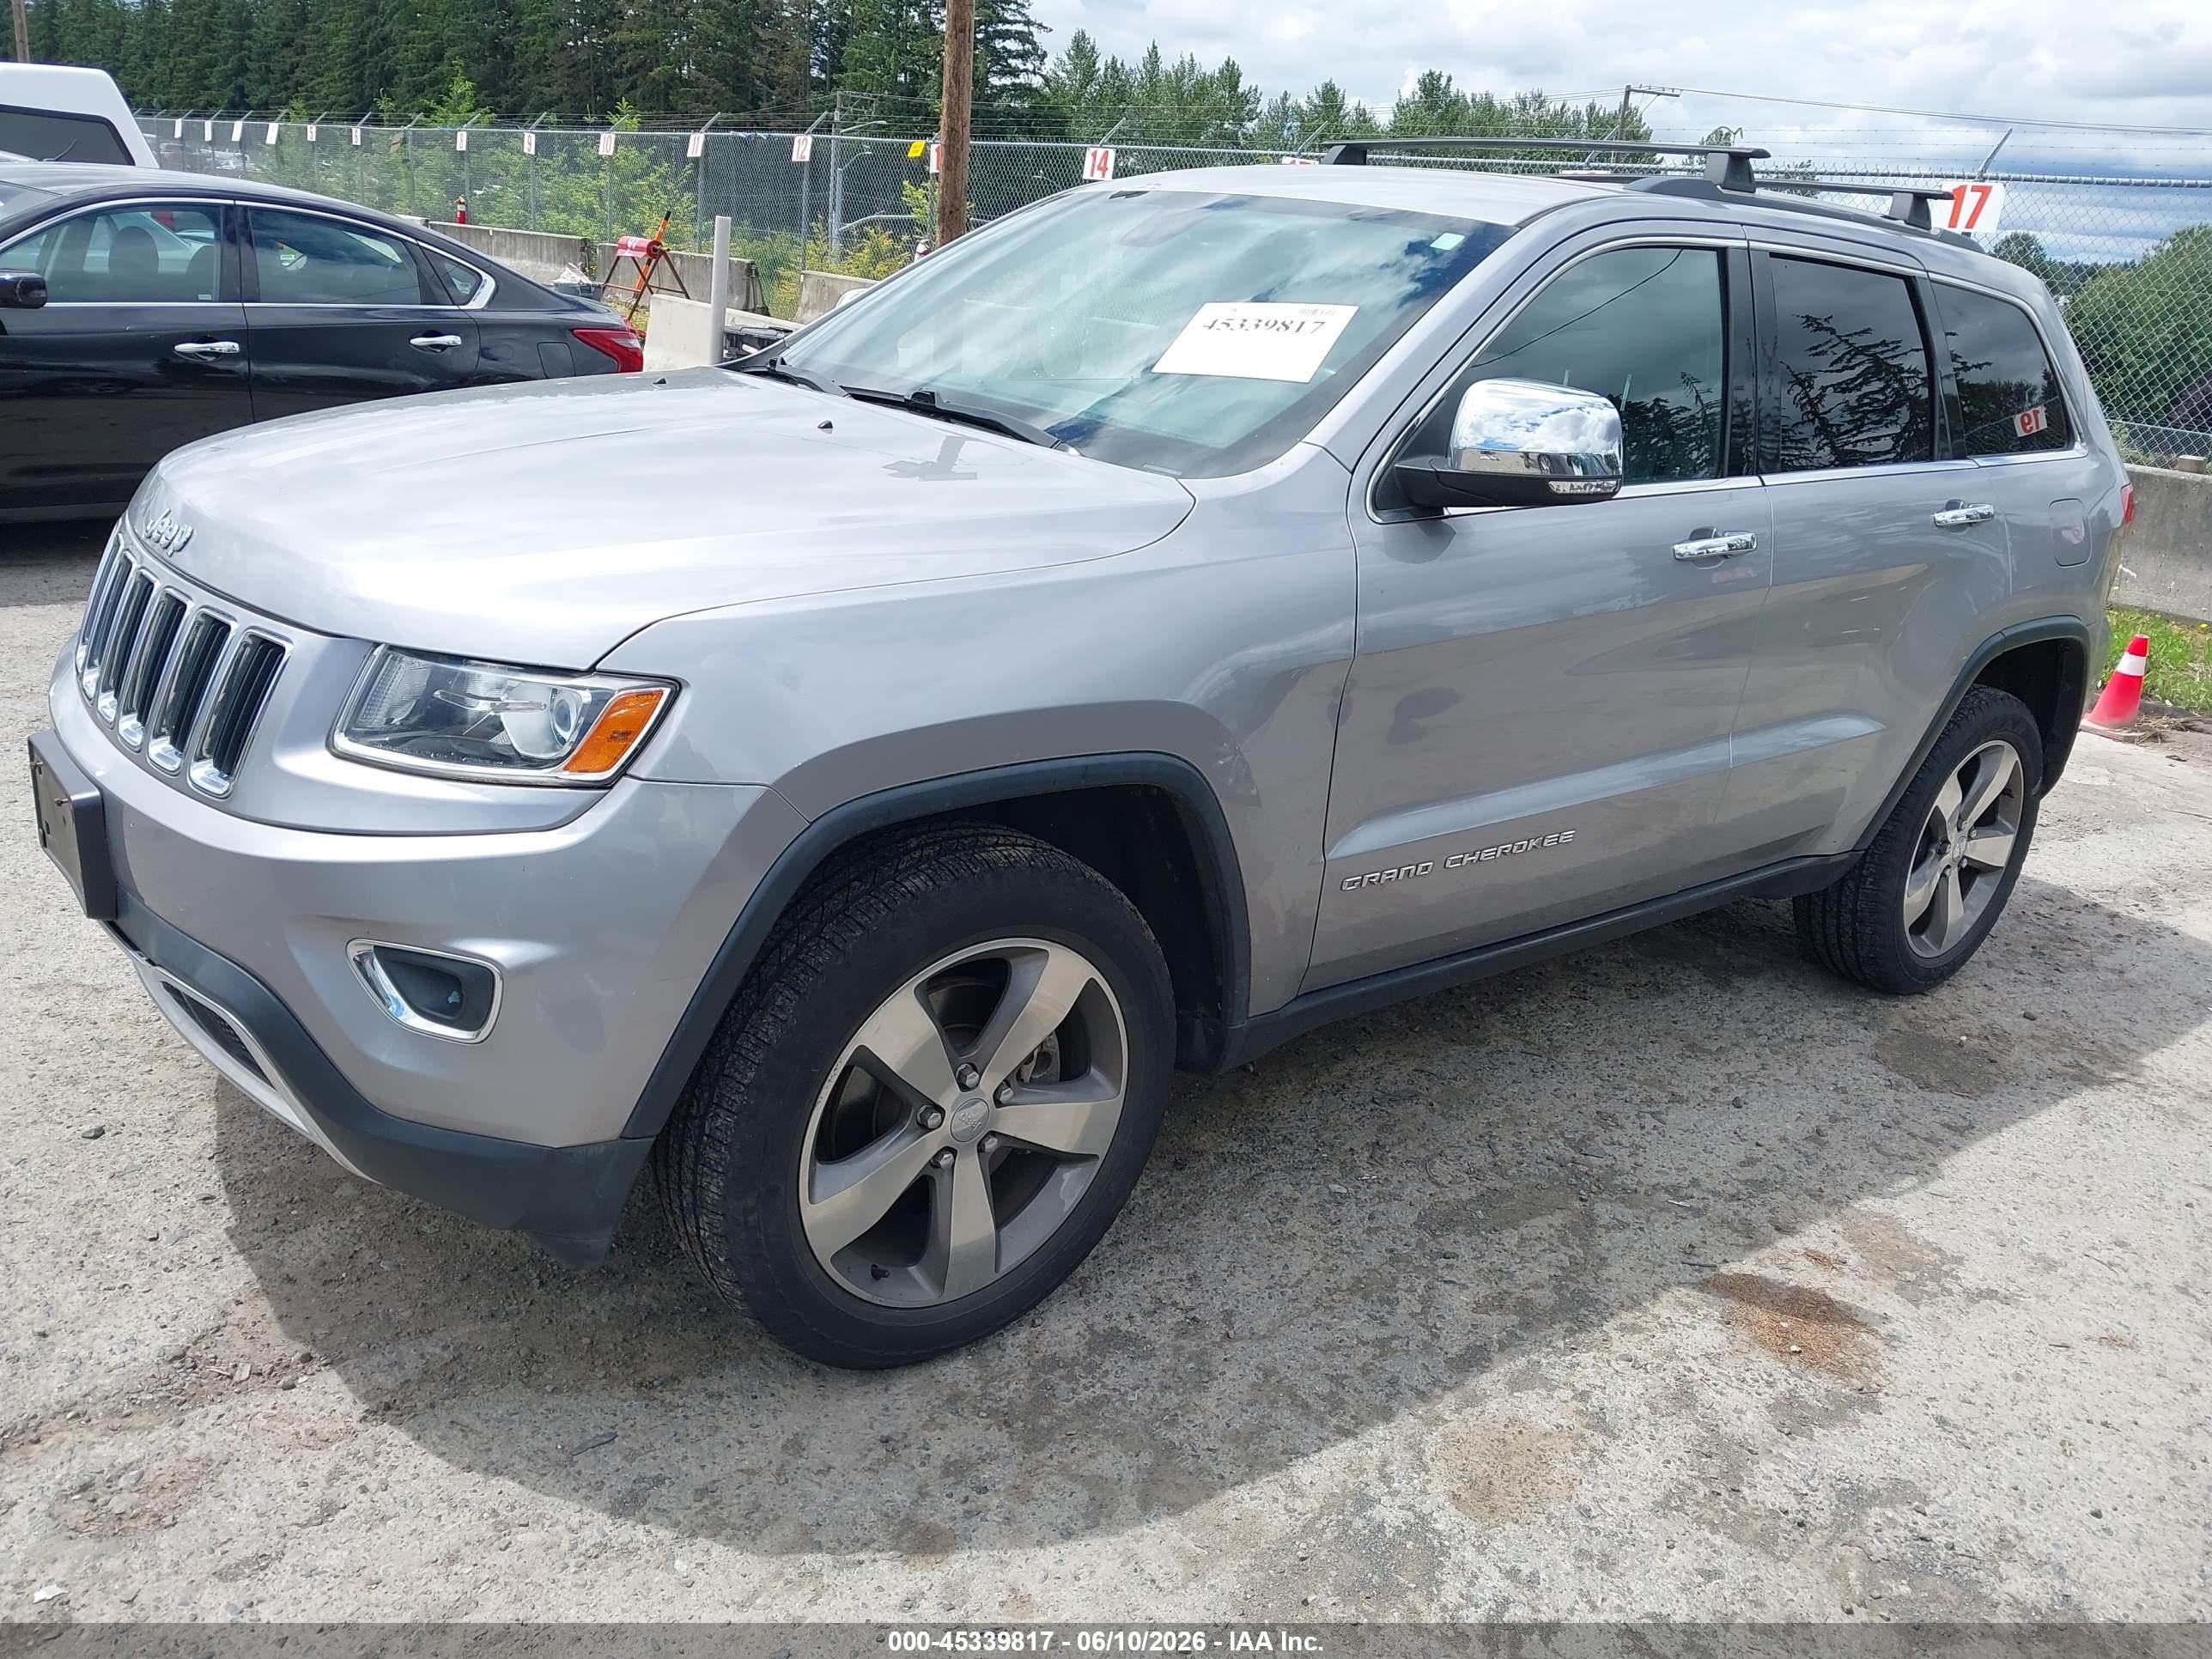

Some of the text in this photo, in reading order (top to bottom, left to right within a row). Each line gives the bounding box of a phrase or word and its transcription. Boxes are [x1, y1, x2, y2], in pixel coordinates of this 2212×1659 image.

[603, 135, 612, 153] 10
[692, 135, 700, 155] 11
[797, 137, 808, 160] 12
[1090, 149, 1109, 178] 14
[1948, 184, 1993, 229] 17
[1203, 319, 1327, 333] 45339817
[145, 507, 194, 558] Jeep
[1340, 830, 1577, 891] GRAND CHEROKEE
